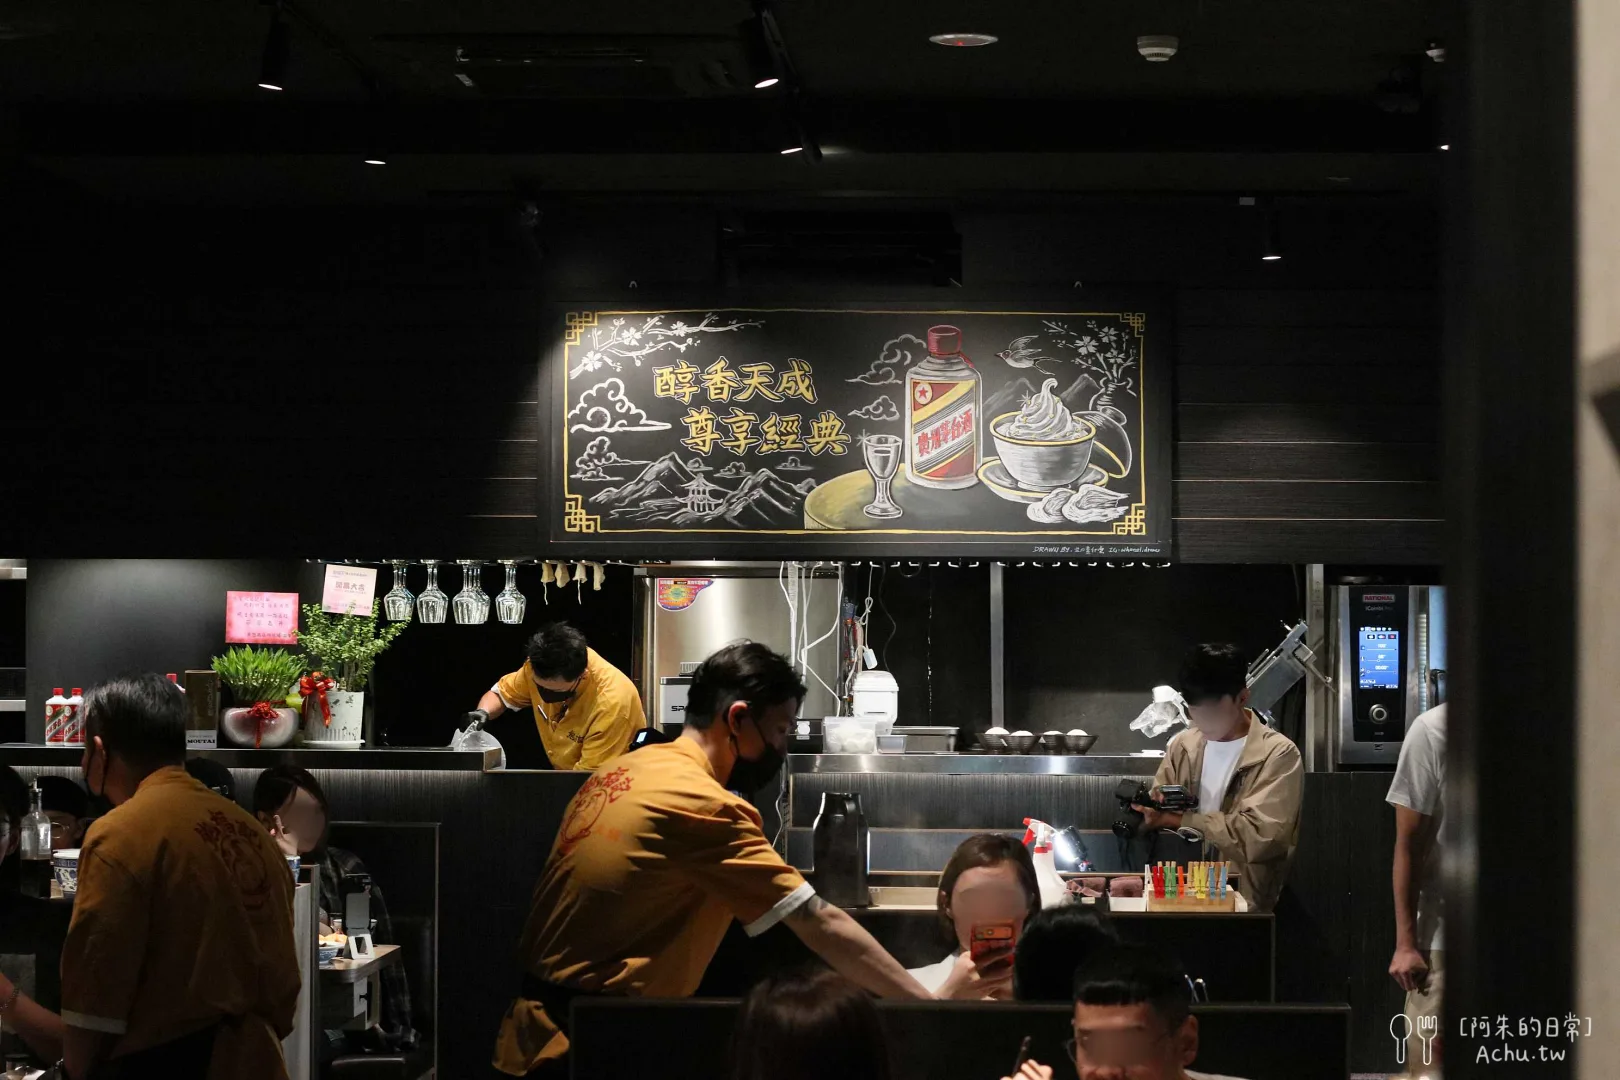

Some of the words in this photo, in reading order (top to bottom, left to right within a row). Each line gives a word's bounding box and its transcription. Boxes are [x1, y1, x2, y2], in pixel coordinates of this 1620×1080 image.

[653, 358, 819, 404] 醇香天成
[680, 406, 851, 457] 尊享經典
